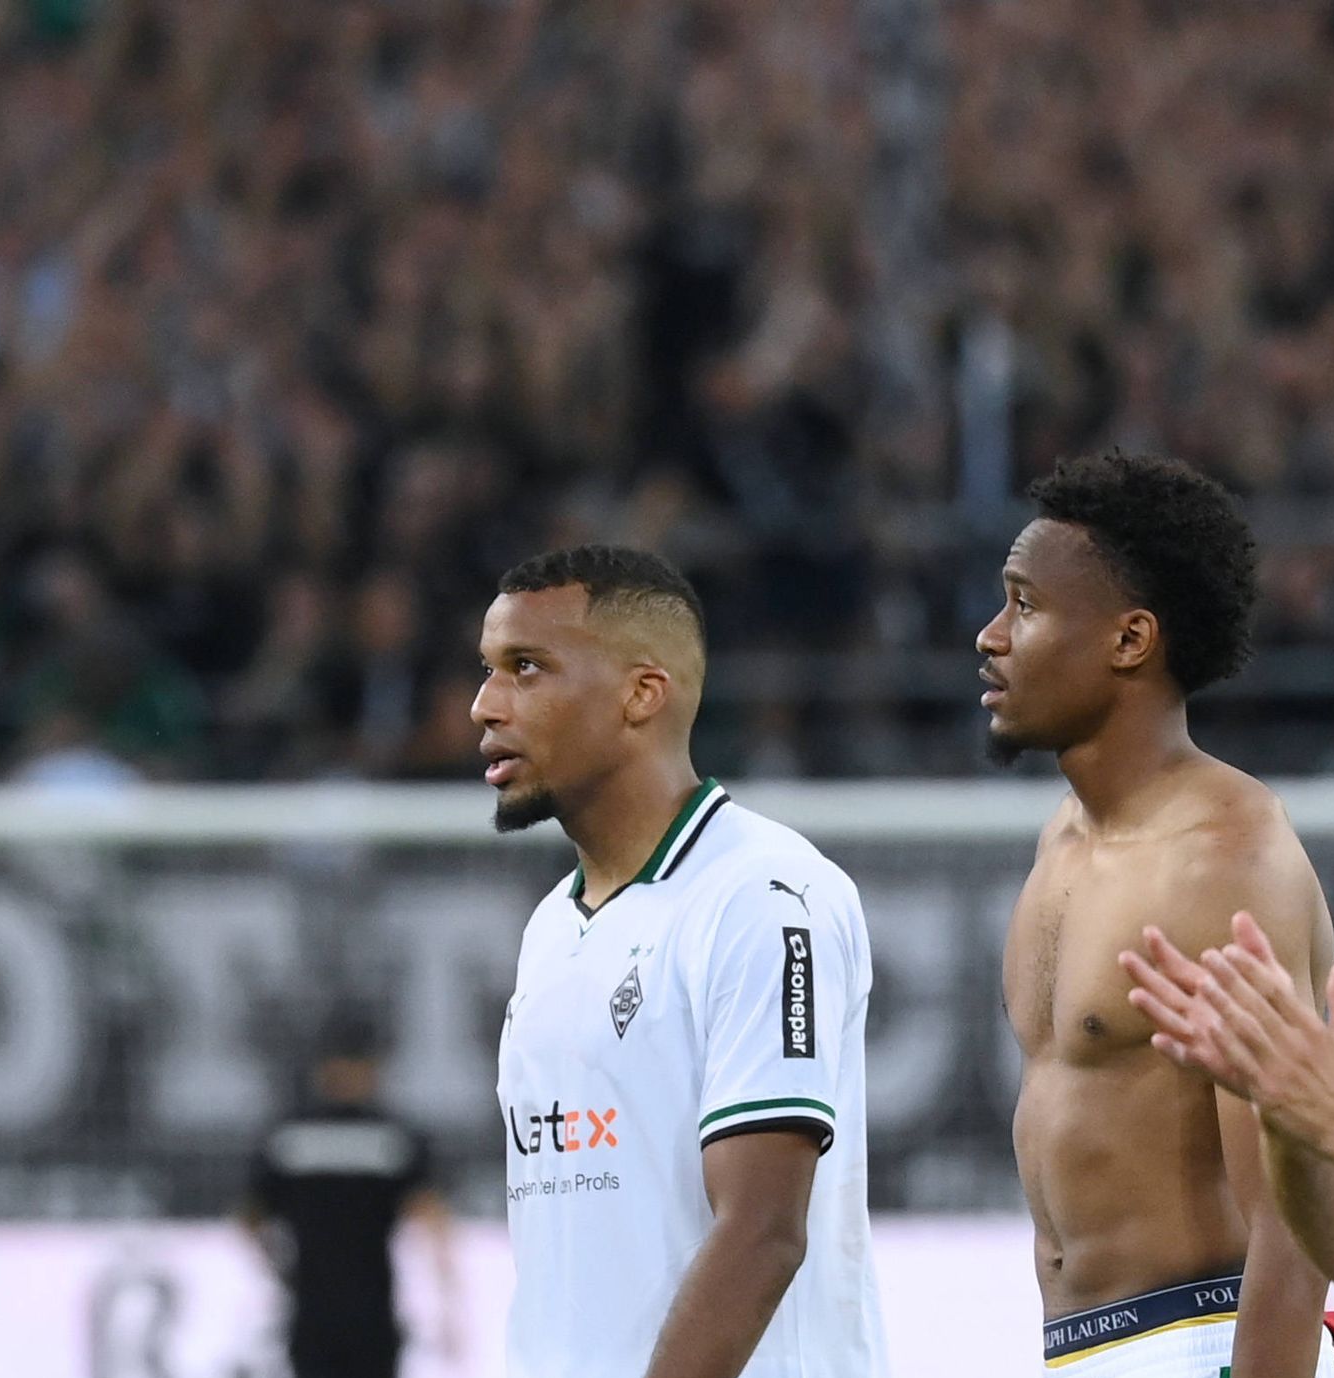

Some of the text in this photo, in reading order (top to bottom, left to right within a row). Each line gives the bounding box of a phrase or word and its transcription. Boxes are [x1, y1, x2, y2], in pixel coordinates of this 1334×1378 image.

[787, 961, 807, 1054] sonepar
[575, 1172, 620, 1192] Profis
[1193, 1286, 1240, 1307] POL
[1068, 1307, 1140, 1343] LAUREN
